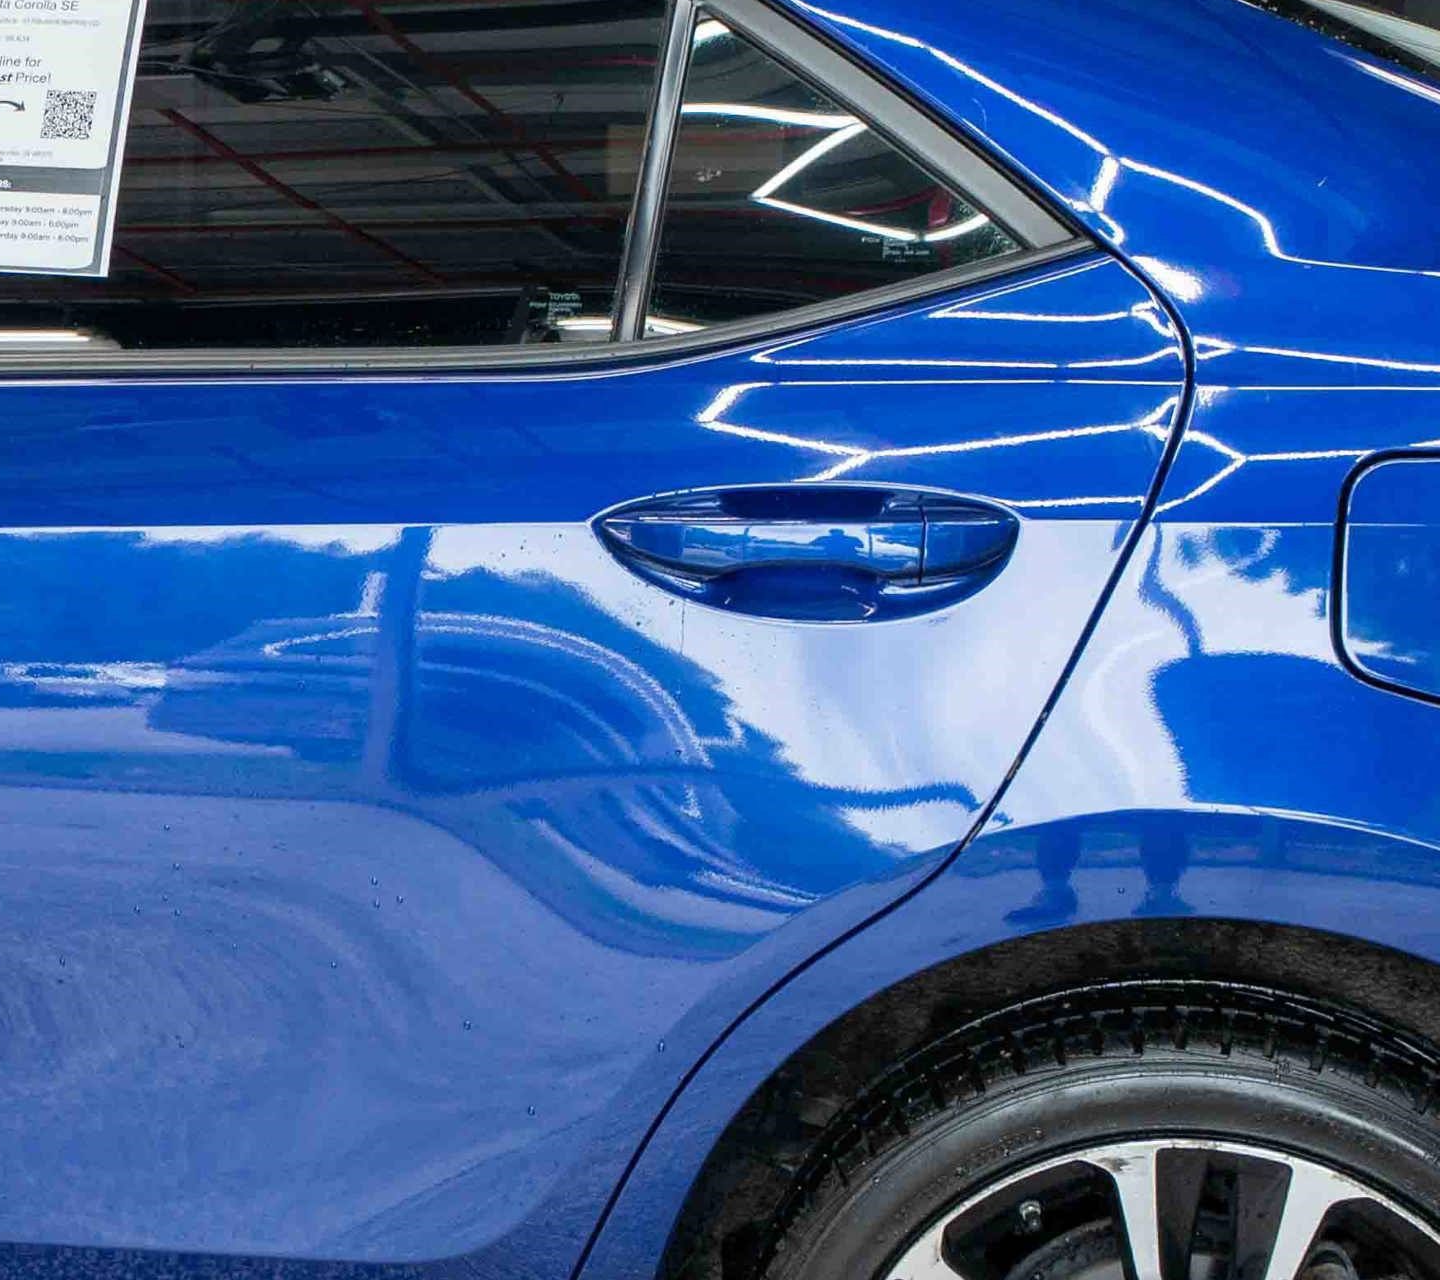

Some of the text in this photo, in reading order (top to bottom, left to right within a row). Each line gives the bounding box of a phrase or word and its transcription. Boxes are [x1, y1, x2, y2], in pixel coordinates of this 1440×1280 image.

[14, 0, 58, 11] Corolla
[60, 0, 80, 11] SE
[25, 55, 43, 68] for
[15, 72, 52, 84] Price!
